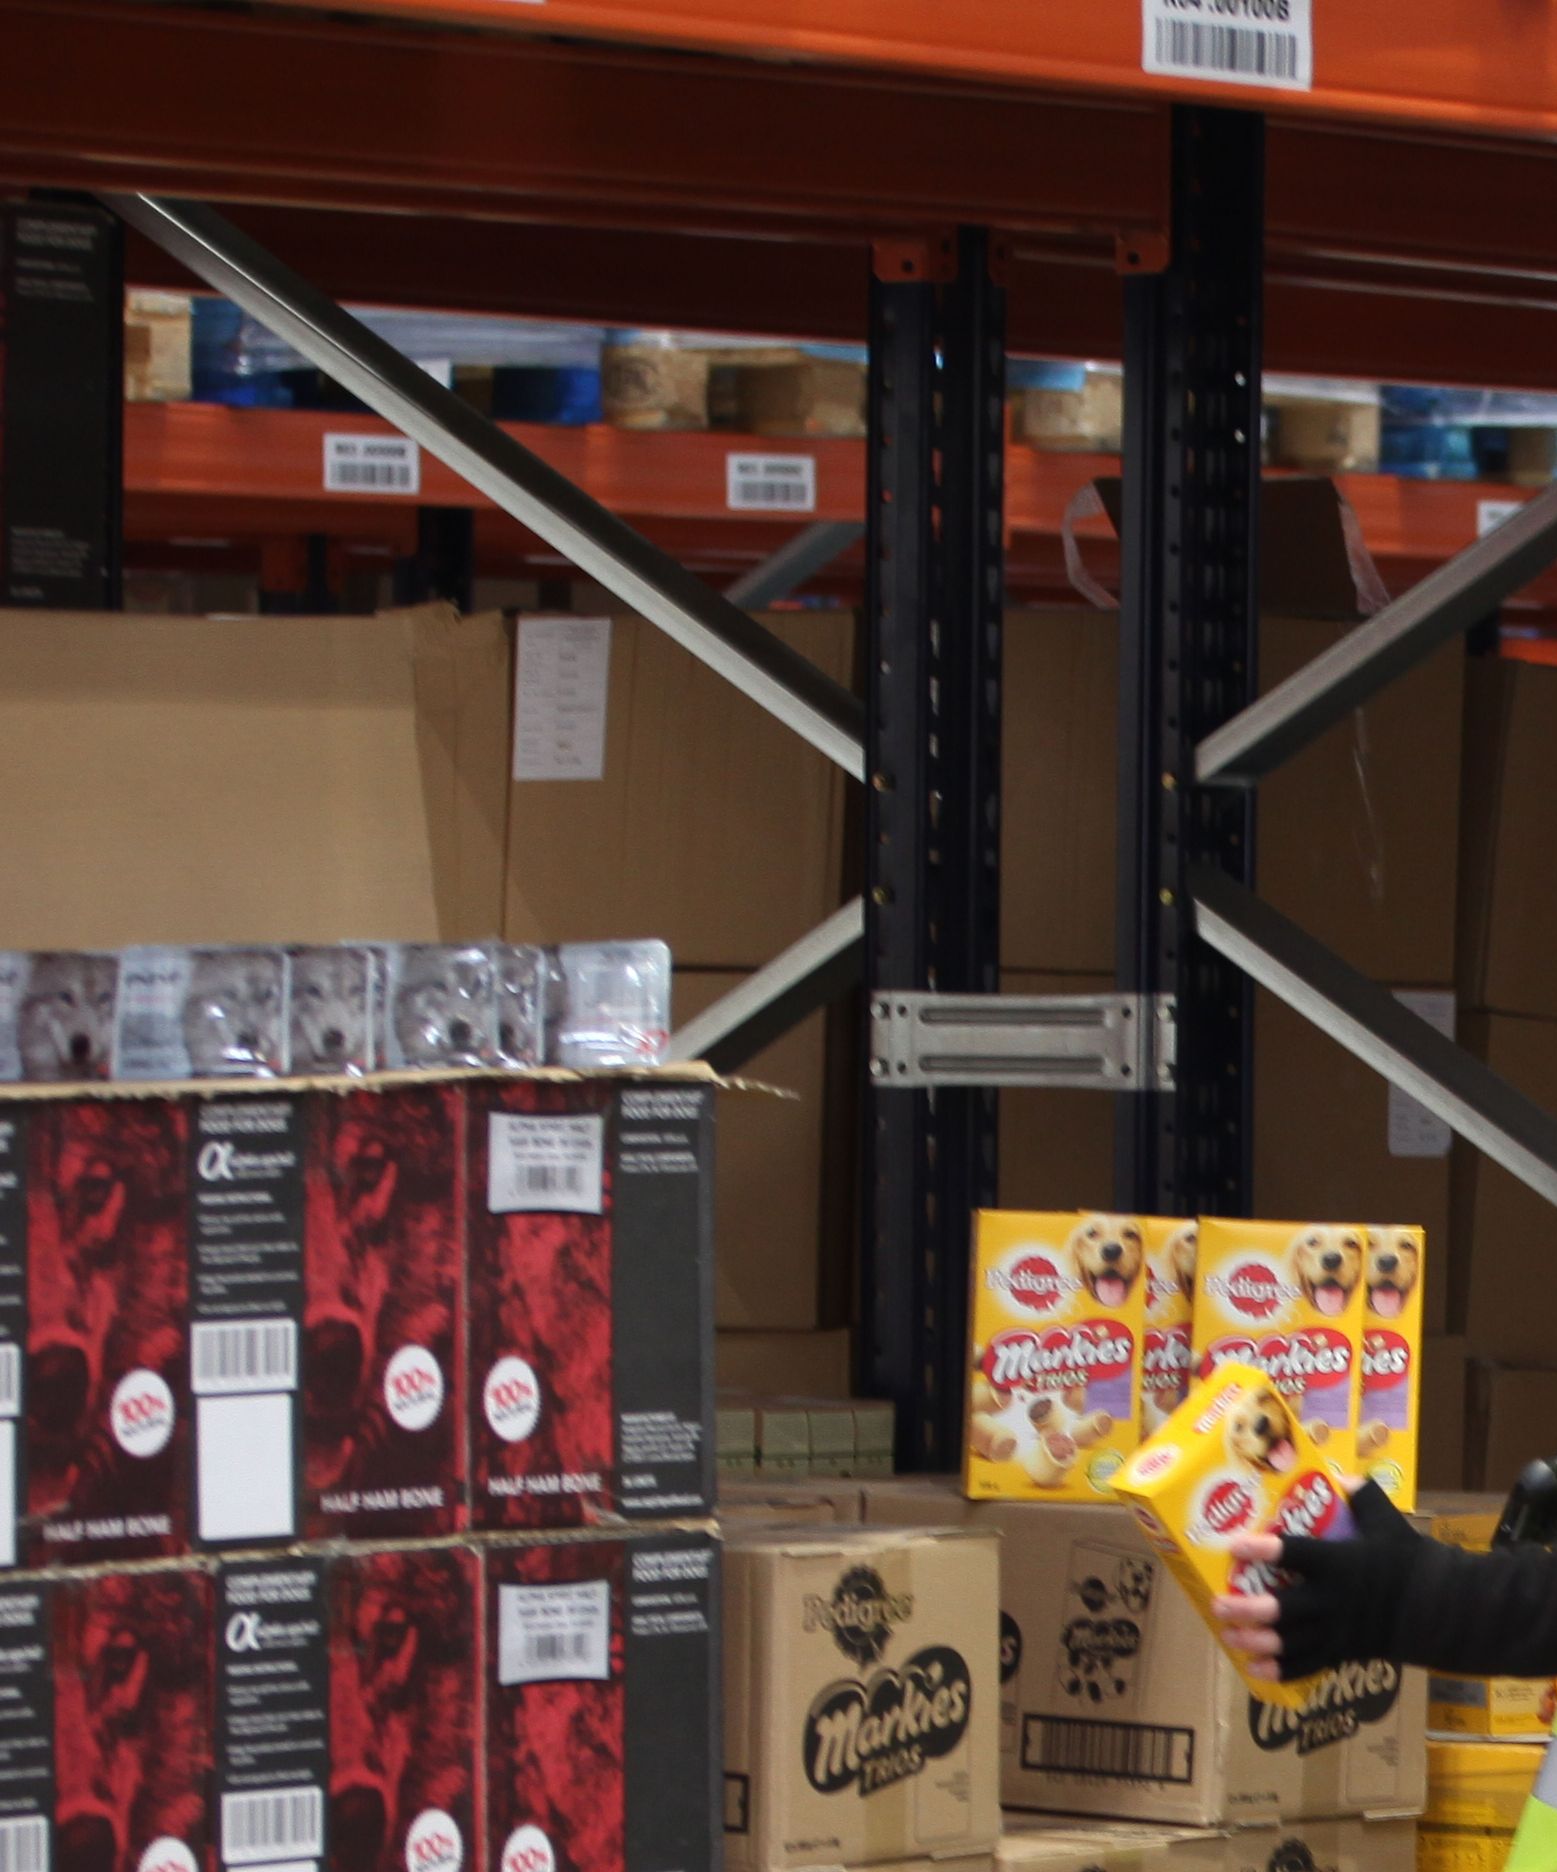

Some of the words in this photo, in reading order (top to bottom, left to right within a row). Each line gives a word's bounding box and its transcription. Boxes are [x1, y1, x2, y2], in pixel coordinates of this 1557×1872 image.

[992, 1326, 1131, 1384] Markies
[803, 1592, 913, 1632] Pedigree
[813, 1664, 967, 1784] Markies
[860, 1744, 923, 1796] TRIOS
